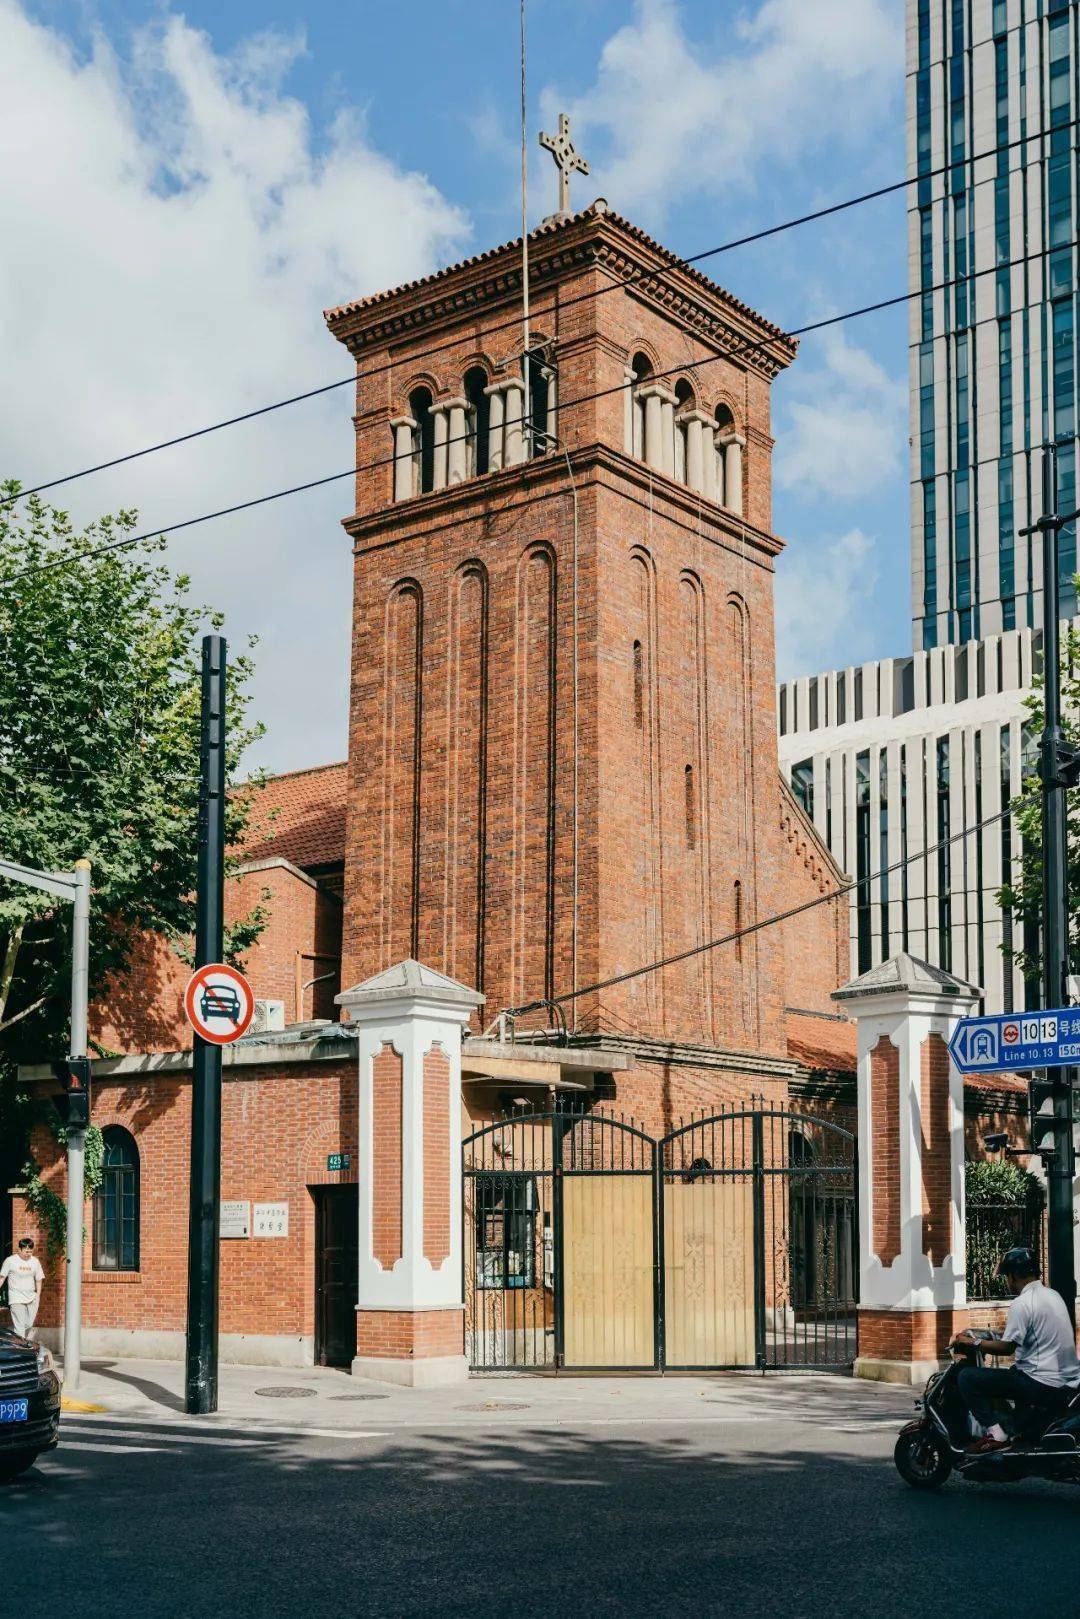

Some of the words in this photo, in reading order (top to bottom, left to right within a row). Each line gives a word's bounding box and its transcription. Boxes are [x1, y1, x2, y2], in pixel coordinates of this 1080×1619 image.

[1023, 1023, 1038, 1040] 10
[1041, 1021, 1057, 1038] 13
[1004, 1051, 1026, 1061] Line
